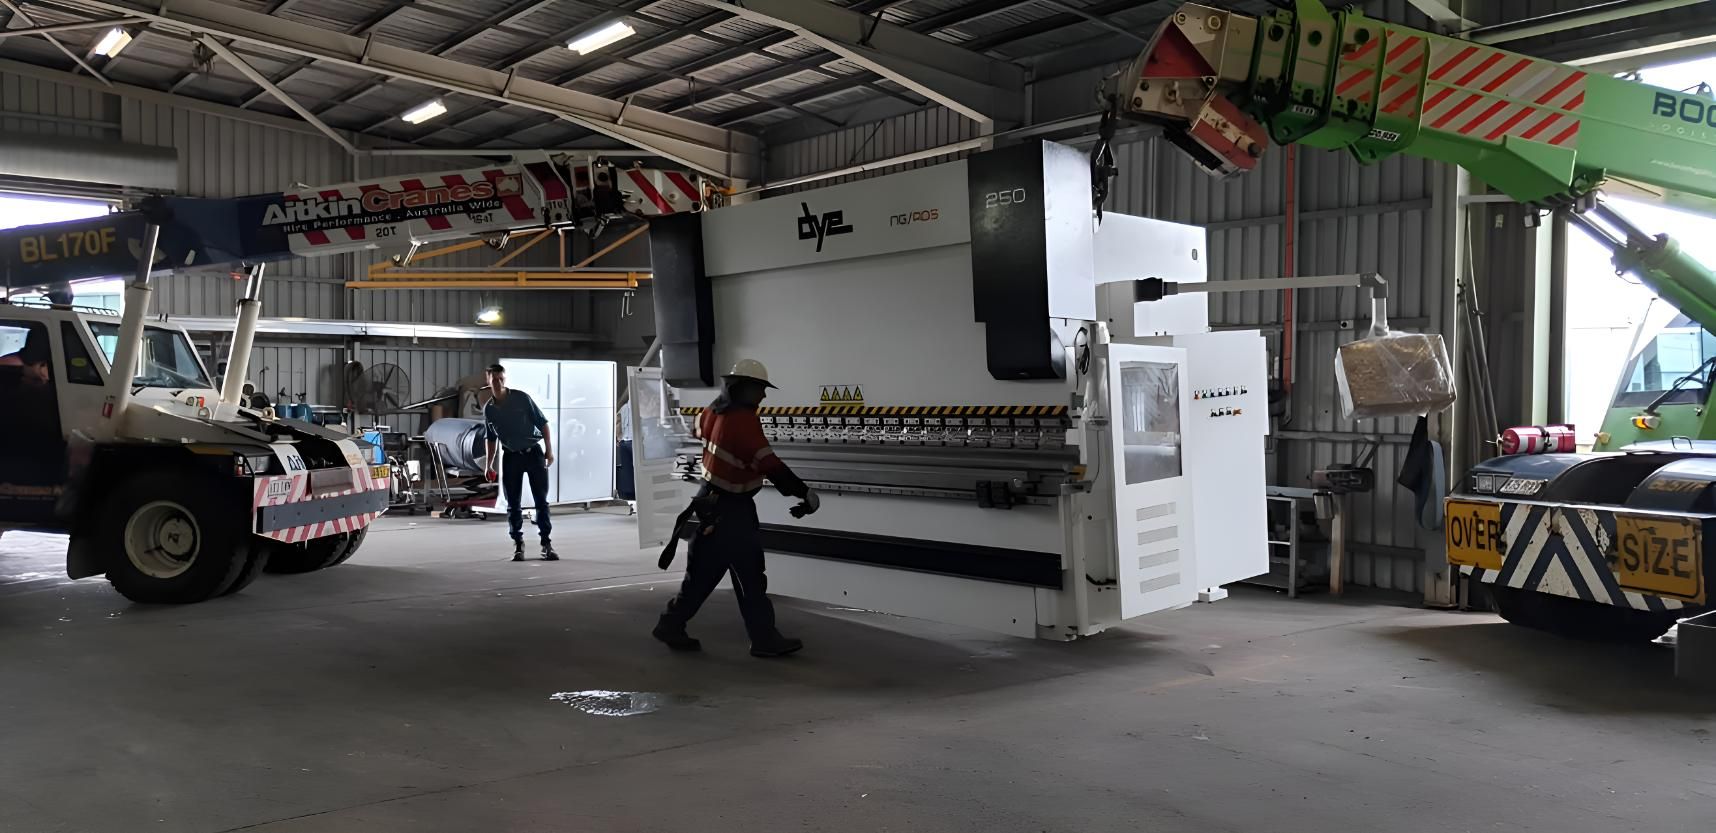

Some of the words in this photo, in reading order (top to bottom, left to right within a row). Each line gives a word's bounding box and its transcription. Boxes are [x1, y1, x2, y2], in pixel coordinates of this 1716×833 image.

[362, 182, 494, 212] Cranes
[985, 188, 1026, 209] 250
[313, 213, 392, 229] Performance
[406, 204, 464, 217] Australia
[468, 200, 500, 210] Wide
[375, 226, 397, 238] 20T
[1451, 515, 1502, 553] OVER
[1623, 533, 1691, 579] SIZE
